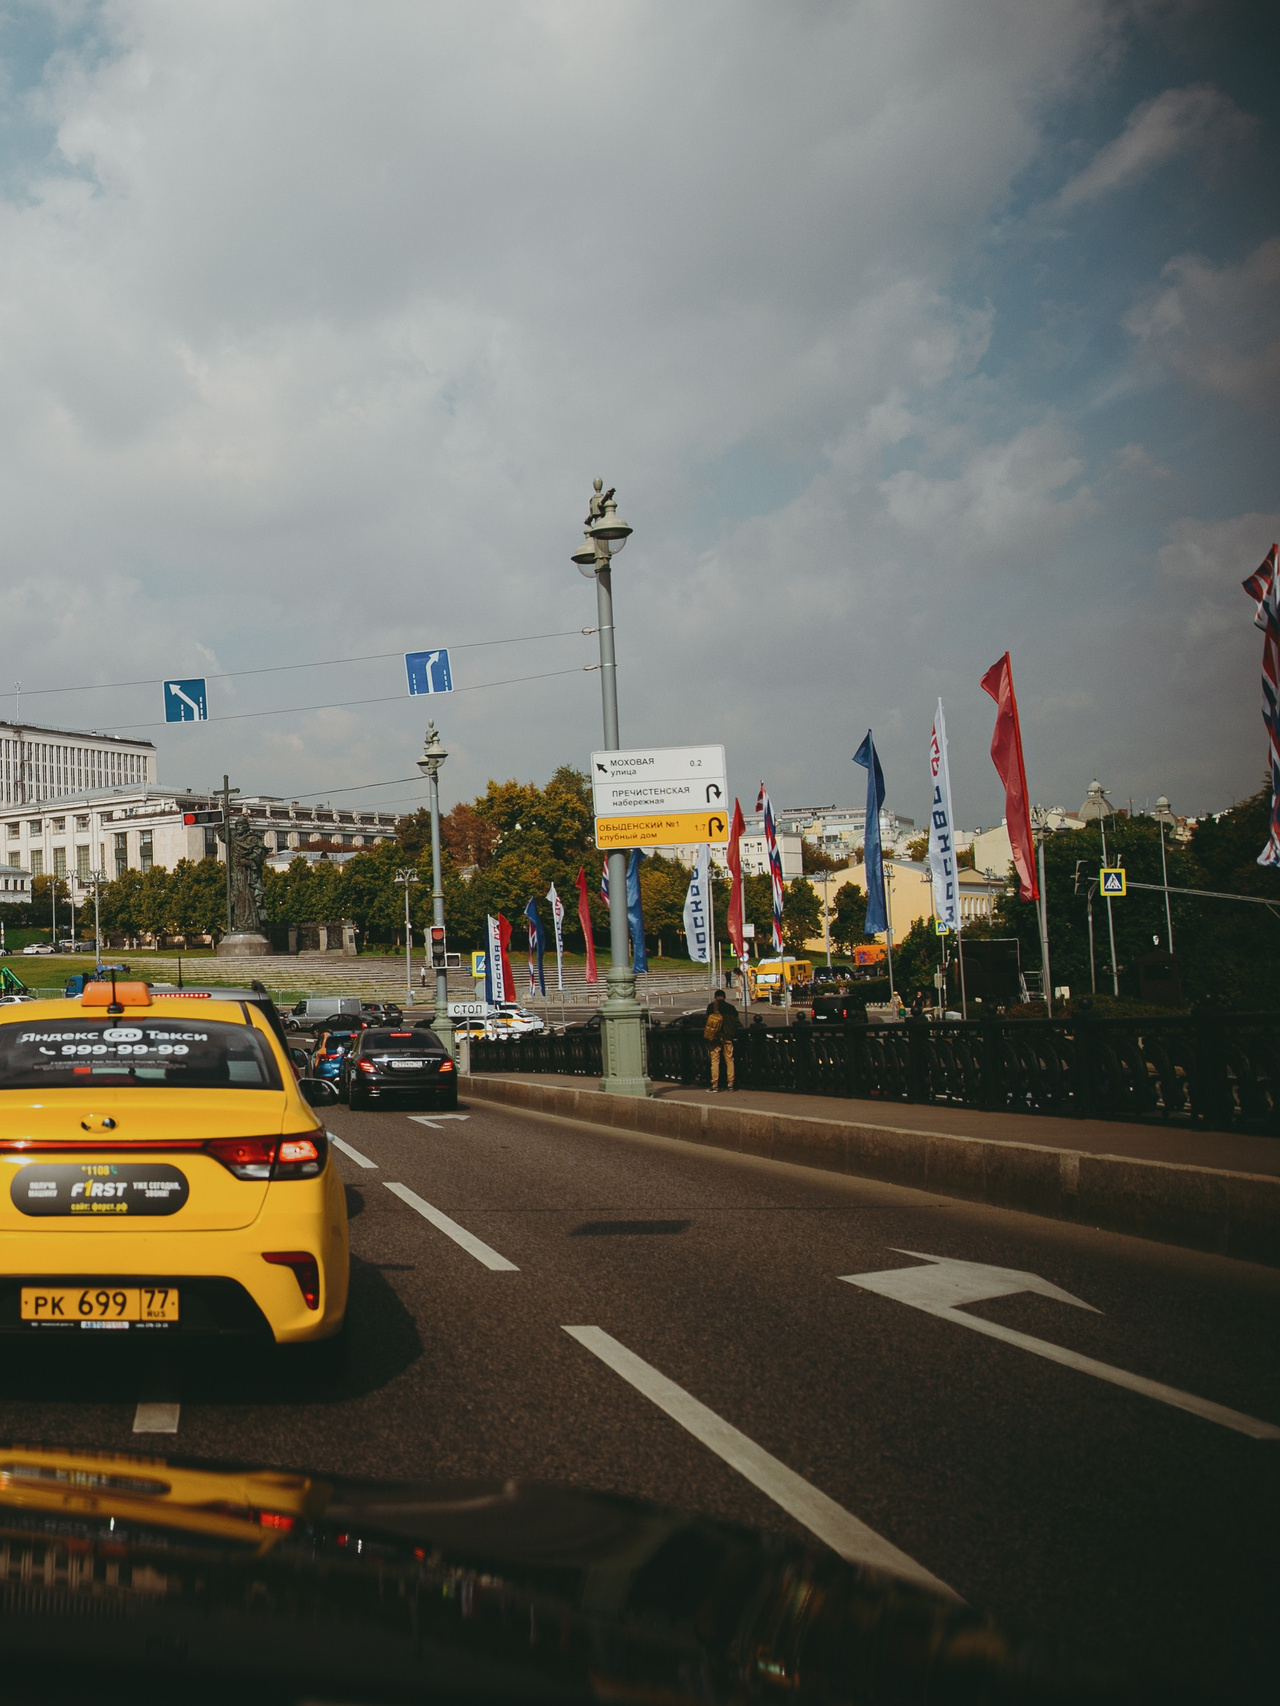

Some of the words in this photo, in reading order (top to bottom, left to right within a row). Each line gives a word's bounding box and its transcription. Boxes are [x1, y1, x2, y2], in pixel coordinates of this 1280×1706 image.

[610, 757, 655, 767] МОХОВАЯ
[689, 759, 702, 767] 0.2
[610, 769, 637, 777] улица
[612, 786, 690, 798] ПРЕЧИСТЕНСКАЯ
[612, 798, 665, 808] набережная
[599, 821, 663, 832] ОБЫДЕНСКИЙ
[665, 821, 680, 829] №1
[599, 832, 638, 842] клубный
[640, 832, 658, 841] дом
[494, 944, 502, 999] МОСКВА
[453, 1004, 483, 1014] СТОП
[20, 1031, 99, 1043] Яндекс
[145, 1030, 208, 1042] Такси
[61, 1044, 190, 1056] 999-99-99
[71, 1178, 128, 1198] F1RST
[34, 1296, 65, 1316] РК
[78, 1289, 127, 1316] 699
[144, 1289, 169, 1309] 77
[146, 1310, 166, 1318] RUS
